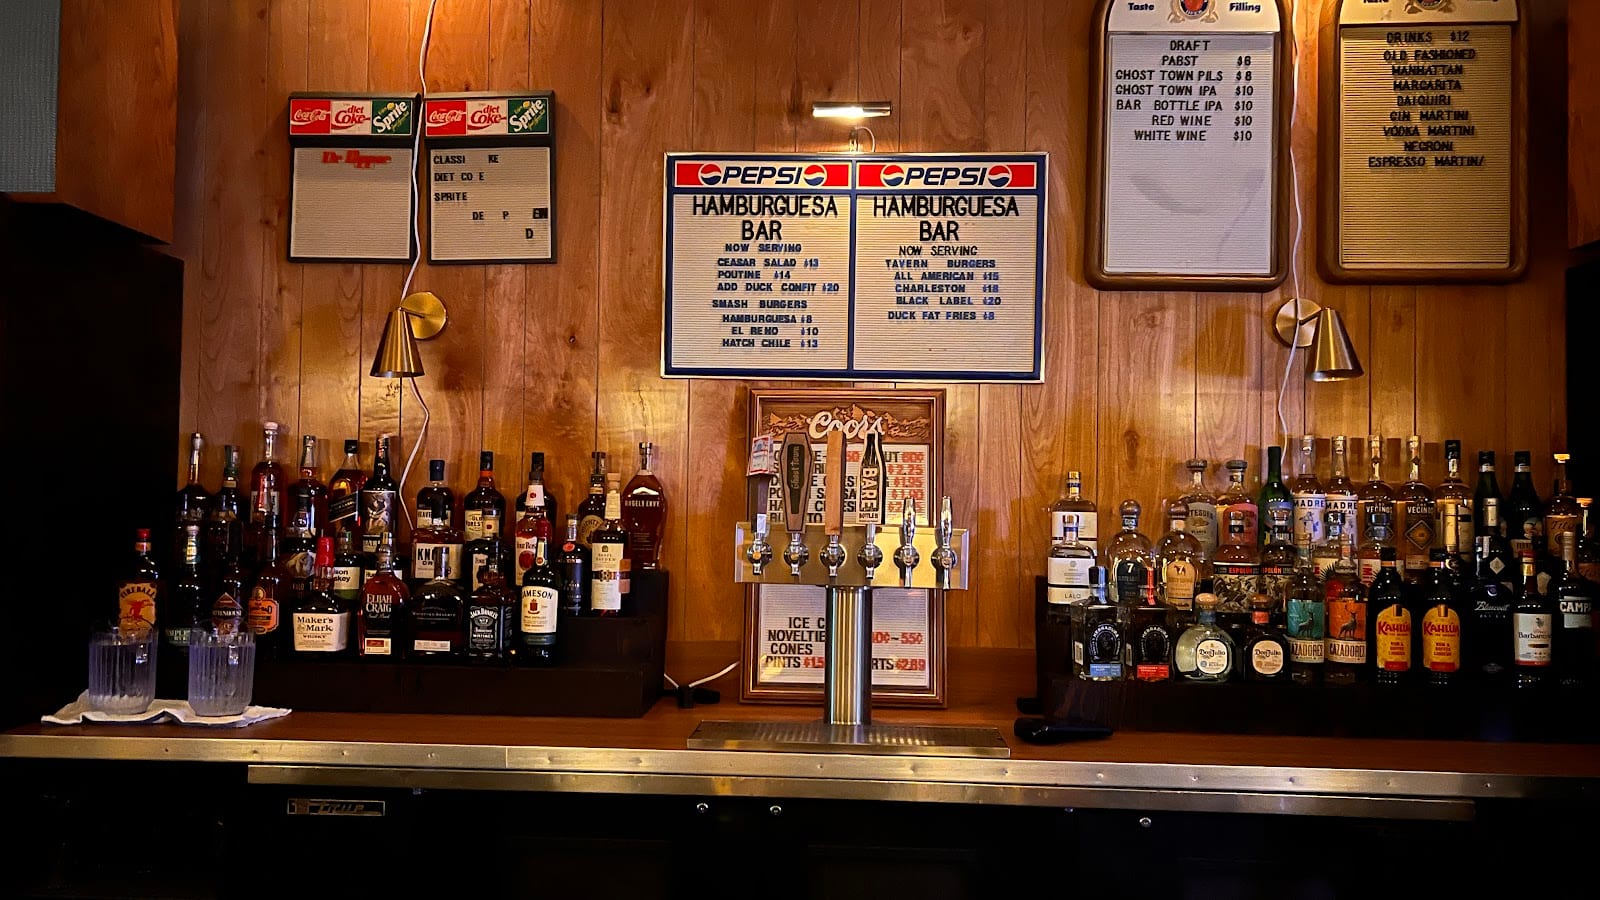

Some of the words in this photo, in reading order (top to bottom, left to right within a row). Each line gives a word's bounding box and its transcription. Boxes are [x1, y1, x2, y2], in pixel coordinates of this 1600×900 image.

[1128, 2, 1155, 11] Taste
[1229, 2, 1261, 13] Filling
[1386, 32, 1433, 43] DRINKS
[1450, 31, 1469, 42] $12
[1170, 40, 1211, 51] DRAFT
[1161, 55, 1198, 66] PABST
[1383, 51, 1407, 61] OLD
[1414, 49, 1476, 60] FASHIONED
[1115, 70, 1155, 81] GHOST
[1161, 70, 1194, 81] TOWN
[1197, 71, 1223, 81] PILS
[1391, 64, 1463, 76] MANHATTAN
[1115, 85, 1154, 95] GHOST
[1159, 85, 1193, 96] TOWN
[1199, 86, 1217, 96] IPA
[1235, 86, 1253, 96] $10
[1393, 80, 1462, 91] MARGARITA
[1116, 99, 1141, 110] BAR
[1154, 100, 1200, 111] BOTTLE
[1205, 101, 1223, 111] IPA
[1234, 100, 1253, 111] $10
[1397, 95, 1451, 106] DAIQUIRI
[347, 105, 364, 115] diet
[483, 104, 500, 115] diet
[335, 110, 370, 124] Coke
[373, 101, 408, 133] Sprite
[470, 110, 506, 124] Coke
[509, 99, 545, 132] Sprite
[1152, 115, 1175, 126] RED
[1180, 115, 1212, 126] WINE
[1234, 116, 1252, 126] $10
[1389, 111, 1411, 122] GIN
[1420, 111, 1469, 121] MARTINI
[1134, 130, 1171, 141] WHITE
[1176, 130, 1207, 141] WINE
[1233, 130, 1252, 141] $10
[1383, 126, 1420, 137] VODKA
[1428, 126, 1475, 136] MARTINI
[1404, 141, 1453, 151] NEGRONI
[1368, 157, 1426, 168] ESPRESSO
[1435, 156, 1484, 167] MARTINI
[434, 172, 455, 182] DIET
[722, 166, 803, 185] PEPSI
[904, 167, 988, 186] PEPSI
[434, 192, 468, 201] SPRITE
[693, 195, 838, 217] HAMBURGUESA
[873, 195, 1019, 217] HAMBURGUESA
[472, 211, 485, 221] DE
[502, 211, 509, 220] P
[525, 228, 534, 240] D
[741, 220, 782, 241] BAR
[919, 220, 959, 241] BAR
[725, 243, 750, 253] NOW
[758, 243, 802, 253] SERVING
[898, 245, 923, 256] NOW
[930, 245, 978, 256] SERVING
[717, 258, 756, 267] CEASAR
[764, 258, 797, 267] SALAD
[885, 259, 928, 268] TAVERN
[947, 259, 996, 268] BURGERS
[717, 270, 761, 279] POUTINE
[774, 270, 791, 279] $14
[894, 272, 913, 281] ALL
[921, 272, 974, 281] AMERICAN
[717, 282, 738, 292] ADD
[745, 282, 773, 292] DUCK
[781, 283, 817, 292] CONFIT
[822, 283, 840, 292] $20
[895, 284, 966, 293] CHARLESTON
[712, 299, 748, 309] SMASH
[759, 299, 808, 309] BURGERS
[896, 296, 929, 305] BLACK
[939, 296, 973, 305] LABEL
[982, 296, 1002, 305] $20
[722, 314, 797, 323] HAMBURGUESA
[888, 311, 916, 320] DUCK
[922, 311, 940, 320] FAT
[946, 311, 976, 320] FRIES
[731, 327, 744, 335] EL
[750, 327, 779, 335] RENO
[800, 327, 819, 336] $10
[722, 339, 755, 348] HATCH
[761, 339, 791, 348] CHILE
[800, 339, 818, 348] $13
[808, 410, 885, 439] Coors
[861, 467, 879, 510] BARE
[1294, 499, 1325, 508] MADRE
[1326, 501, 1357, 510] MADRE
[1127, 563, 1134, 573] 7
[1179, 565, 1184, 574] 7
[120, 586, 156, 599] FIREBALL
[367, 594, 393, 604] ELIJAH
[365, 603, 392, 614] CRAIG
[297, 616, 334, 624] Maker's
[789, 617, 810, 629] ICE
[306, 624, 333, 632] Mark
[768, 630, 825, 642] NOVELTIE
[770, 643, 813, 655] CONES
[1199, 648, 1212, 656] Don
[1254, 648, 1267, 656] Don
[765, 656, 801, 668] PINTS
